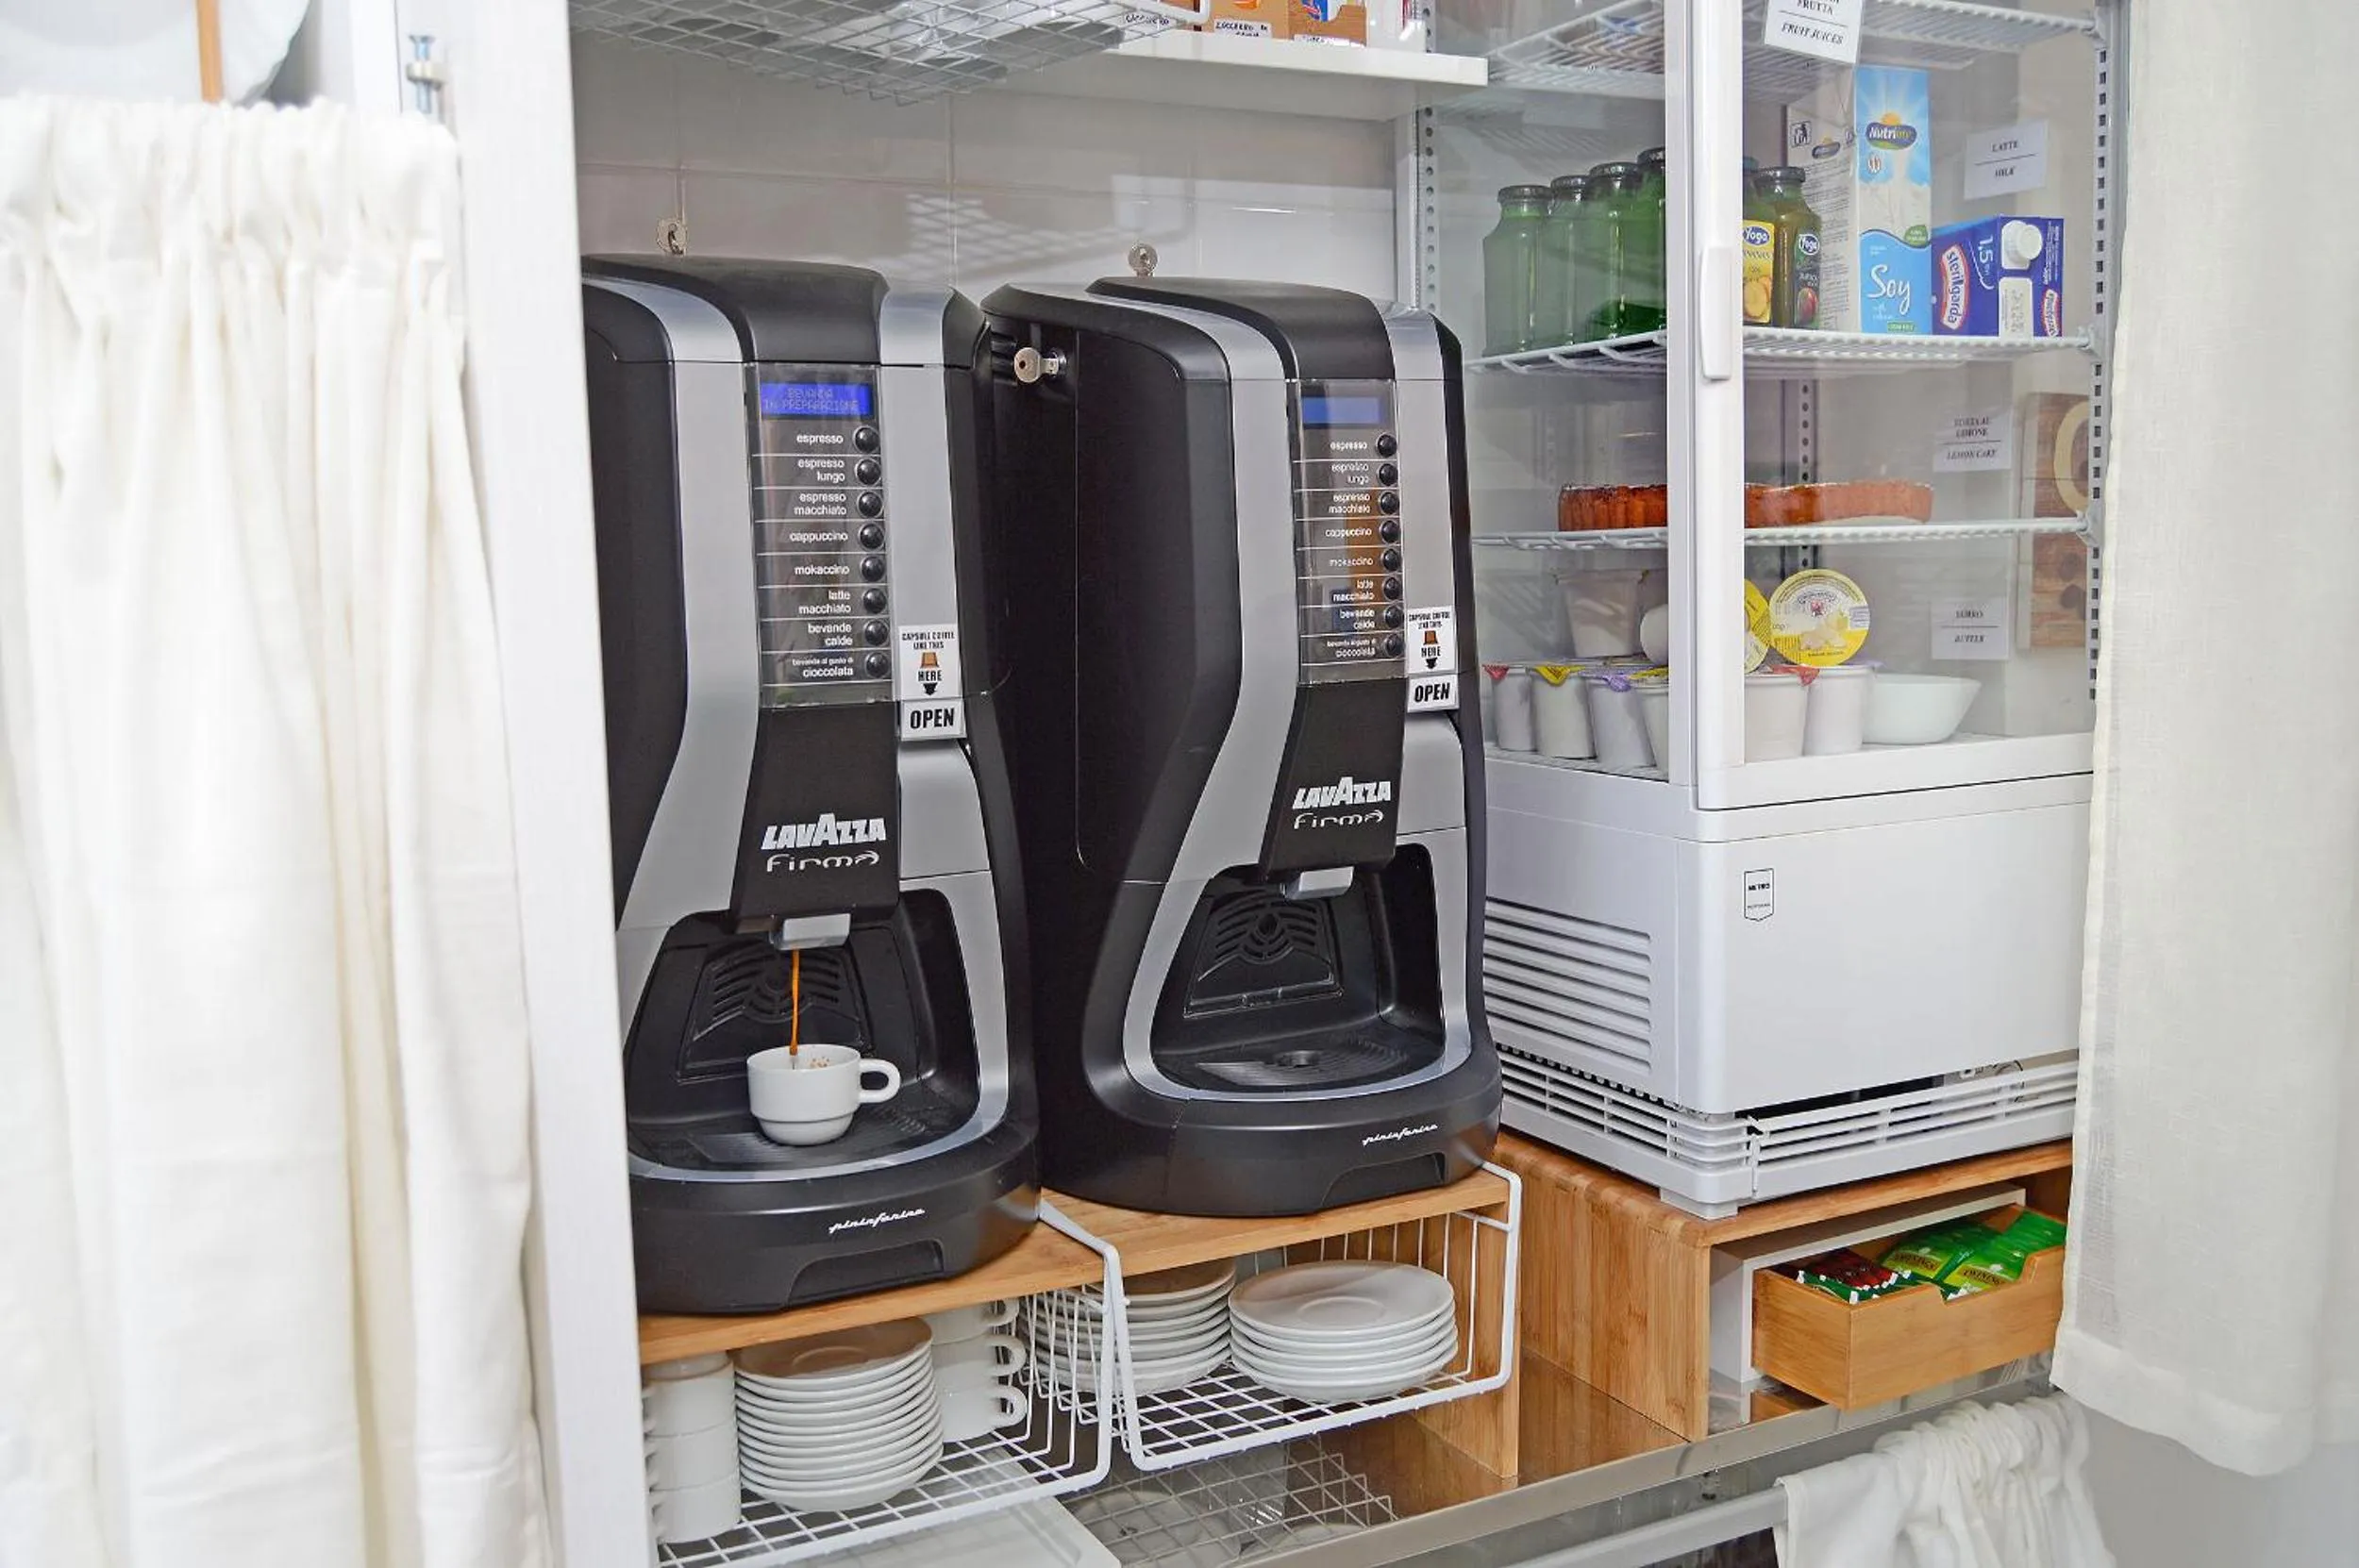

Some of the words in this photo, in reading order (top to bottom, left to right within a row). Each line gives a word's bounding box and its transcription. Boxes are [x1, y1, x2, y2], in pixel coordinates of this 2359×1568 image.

[1798, 0, 1833, 15] FRUTTA
[1782, 22, 1810, 37] FRUIT
[1810, 29, 1844, 44] JUICES
[1991, 140, 2019, 153] LATTE
[1745, 226, 1769, 244] Yoga
[1867, 263, 1911, 315] Soy
[1947, 251, 1965, 325] sterilgarda
[796, 433, 844, 445] espresso
[1330, 442, 1368, 452] espresso
[798, 458, 845, 470] espresso
[817, 471, 845, 483] lungo
[799, 492, 846, 504] espresso
[794, 505, 847, 515] macchiato
[1329, 504, 1370, 513] macchiato
[790, 530, 848, 542] cappuccino
[1325, 528, 1372, 538] cappuccino
[795, 564, 850, 575] mokaccino
[828, 590, 851, 600] latte
[1332, 592, 1375, 602] macchiato
[798, 603, 851, 614] macchiato
[808, 623, 852, 634] bevande
[825, 635, 853, 646] calde
[1421, 646, 1441, 658] HERE
[803, 665, 854, 677] cioccolata
[918, 670, 943, 681] HERE
[1414, 682, 1450, 703] OPEN
[910, 709, 955, 729] OPEN
[1292, 776, 1391, 809] LAVAZZA
[761, 812, 887, 850] LAVAZZA
[828, 1209, 925, 1234] pininfarina
